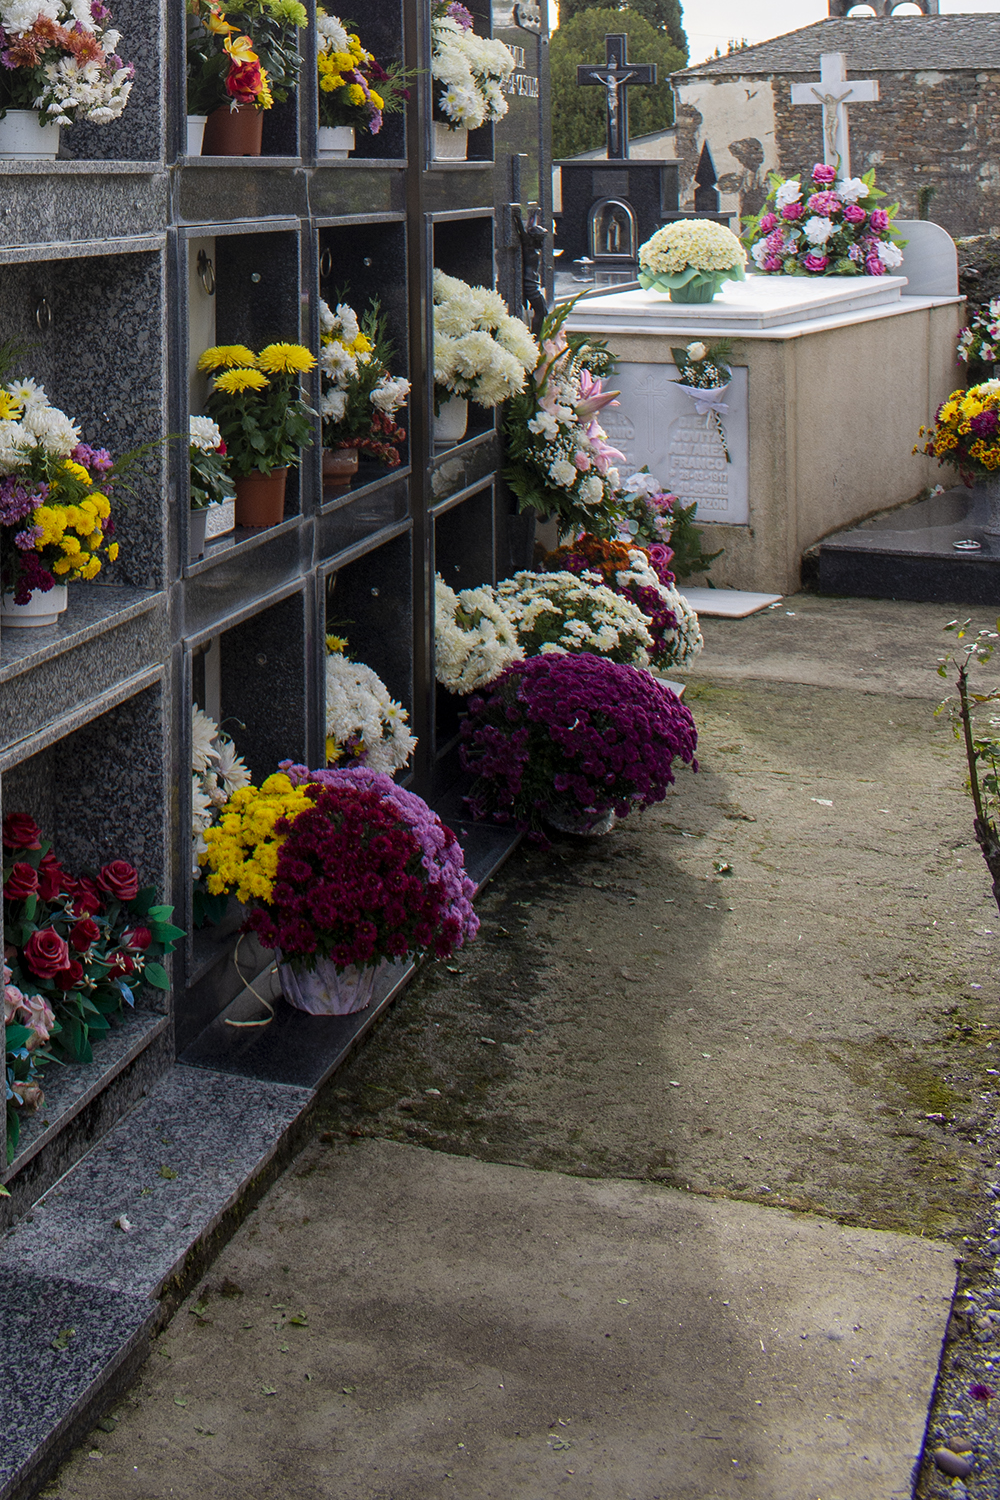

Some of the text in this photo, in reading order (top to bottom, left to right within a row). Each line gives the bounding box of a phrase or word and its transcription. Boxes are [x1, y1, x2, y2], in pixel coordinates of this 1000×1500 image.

[672, 429, 722, 444] JOVITA
[669, 442, 727, 456] ALVAREZ
[671, 455, 726, 471] FRANCO
